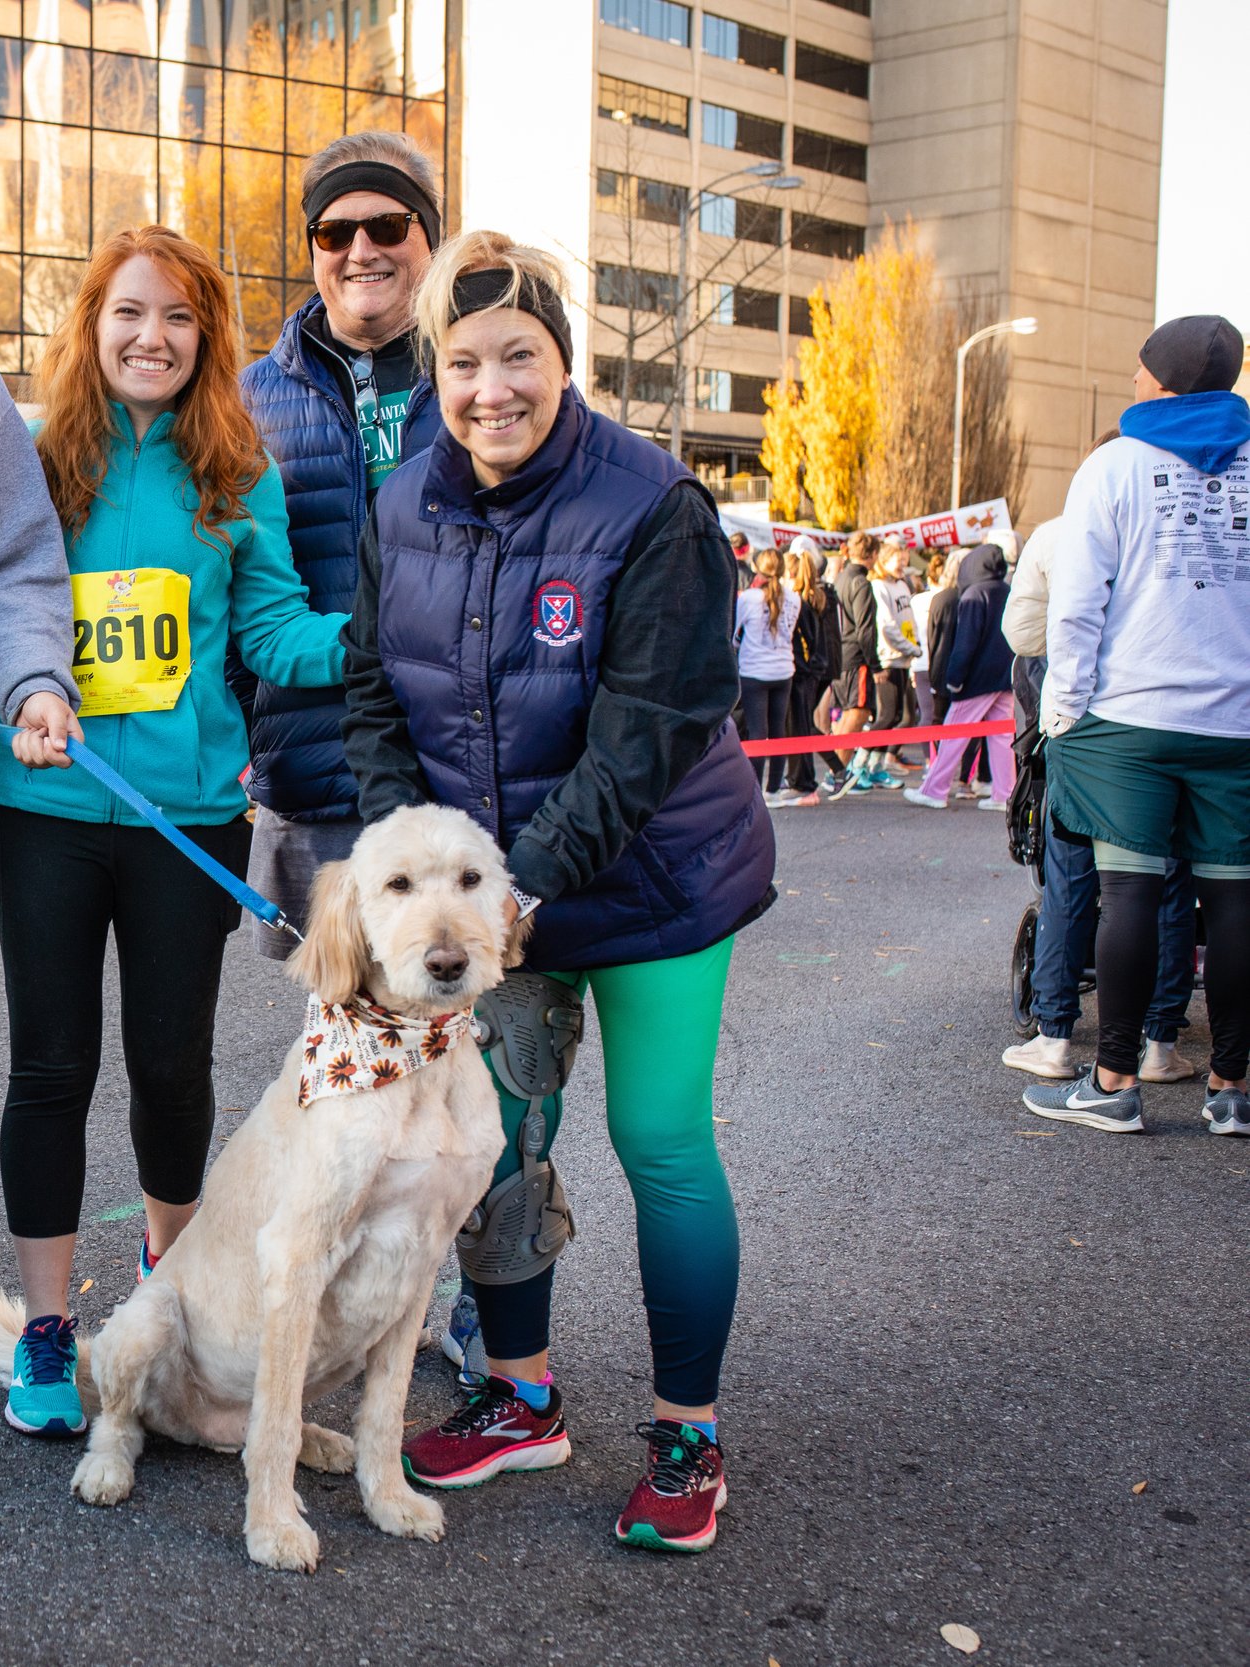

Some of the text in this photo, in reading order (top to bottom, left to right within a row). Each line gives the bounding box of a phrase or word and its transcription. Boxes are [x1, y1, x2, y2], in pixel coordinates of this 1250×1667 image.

[372, 403, 407, 421] SANTA
[922, 519, 954, 538] START
[73, 613, 179, 667] 2610
